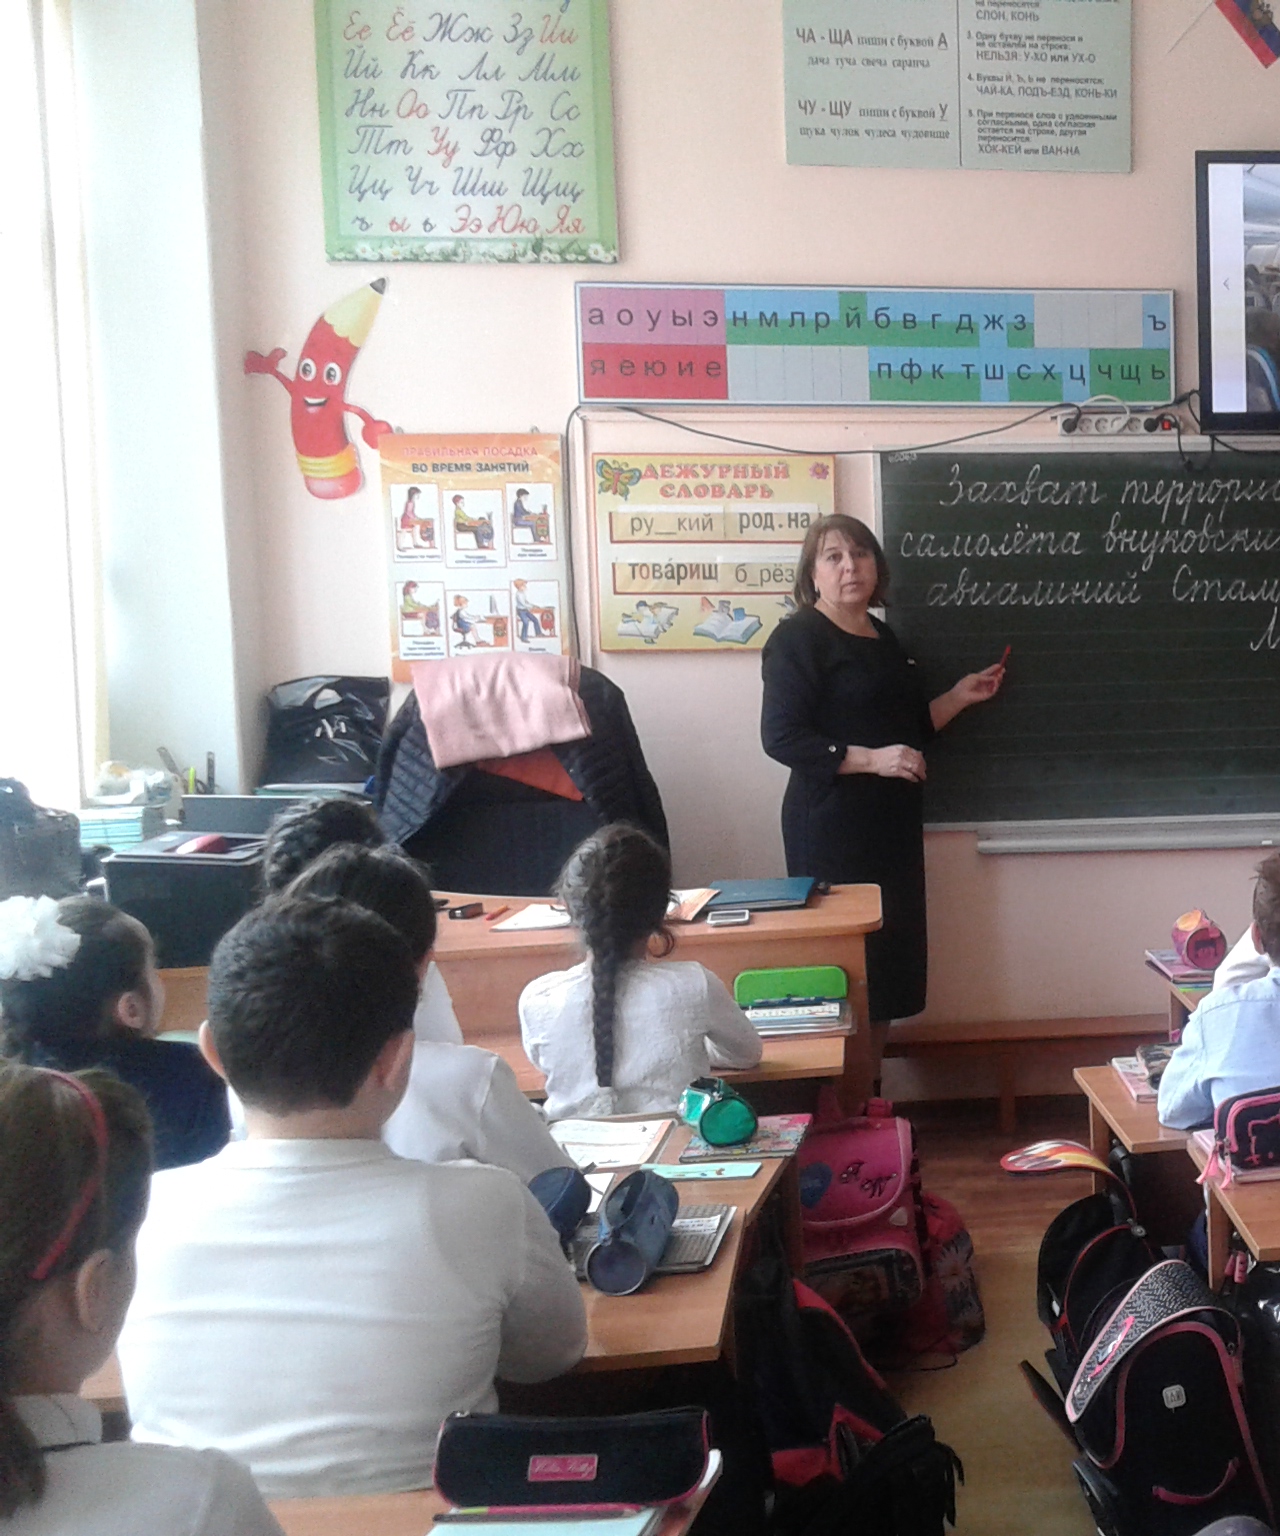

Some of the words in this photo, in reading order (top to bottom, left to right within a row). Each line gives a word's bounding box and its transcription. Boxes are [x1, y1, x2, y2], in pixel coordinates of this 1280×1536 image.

[343, 11, 372, 42] Ее
[386, 7, 415, 43] Ёё
[423, 12, 492, 44] Жж
[503, 12, 536, 56] Зз
[540, 13, 579, 45] Ии
[796, 27, 816, 44] ЧА
[828, 28, 853, 47] ЩА
[857, 37, 888, 47] пиши
[898, 35, 934, 51] буквой
[938, 32, 948, 50] А
[343, 45, 382, 81] Йй
[400, 49, 440, 82] Кк
[458, 50, 505, 82] Лл
[518, 53, 581, 82] Мм
[344, 87, 389, 120] Нн
[397, 88, 430, 120] Оо
[439, 89, 489, 121] Пп
[495, 89, 534, 133] Рр
[549, 90, 581, 121] Сс
[798, 99, 817, 115] ЧУ
[829, 100, 851, 119] ЩУ
[859, 108, 889, 118] пиши
[899, 106, 936, 122] буквой
[939, 103, 948, 120] У
[348, 124, 413, 155] Тт
[427, 127, 460, 168] Уу
[474, 128, 518, 169] Фф
[530, 128, 585, 158] Хх
[349, 165, 393, 201] Цц
[405, 165, 440, 196] Чч
[452, 167, 508, 198] Шш
[521, 167, 585, 206] Щщ
[351, 217, 372, 232] ъ
[388, 216, 410, 234] ы
[422, 215, 437, 232] ь
[450, 204, 484, 234] Ээ
[488, 203, 540, 235] Юю
[546, 204, 586, 235] Яя
[588, 307, 604, 325] а
[617, 308, 633, 326] о
[646, 309, 661, 332] у
[672, 310, 693, 327] ы
[703, 310, 719, 327] э
[732, 310, 747, 327] н
[759, 311, 778, 328] м
[789, 311, 805, 328] л
[814, 312, 830, 333] р
[845, 307, 861, 329] й
[874, 307, 891, 329] б
[903, 313, 917, 329] в
[931, 314, 942, 329] г
[956, 313, 973, 333] д
[983, 314, 1004, 330] ж
[1013, 314, 1027, 330] з
[1148, 314, 1167, 331] ъ
[590, 359, 605, 376] я
[620, 359, 636, 376] е
[643, 359, 667, 377] ю
[678, 360, 694, 377] и
[706, 360, 722, 377] е
[878, 362, 891, 379] п
[900, 358, 922, 385] ф
[932, 363, 944, 380] к
[961, 363, 975, 380] т
[985, 363, 1004, 380] ш
[1017, 363, 1031, 380] с
[1042, 363, 1056, 380] х
[1070, 364, 1086, 387] ц
[1097, 364, 1112, 380] ч
[1120, 364, 1140, 384] щ
[1152, 364, 1165, 380] ь
[402, 446, 479, 457] ПРАВИЛЬНАЯ
[483, 447, 538, 457] ПОСАДКА
[412, 463, 428, 473] ВО
[432, 463, 472, 473] ВРЕМЯ
[476, 461, 530, 473] ЗАНЯТИЙ
[641, 460, 790, 480] ДЕЖУРНЫЙ
[659, 483, 774, 499] СЛОВАРЬ
[939, 463, 1107, 507] Захват
[900, 522, 1084, 558] самолёта
[735, 563, 796, 586] б_рёз
[927, 567, 1141, 607] авиалиний
